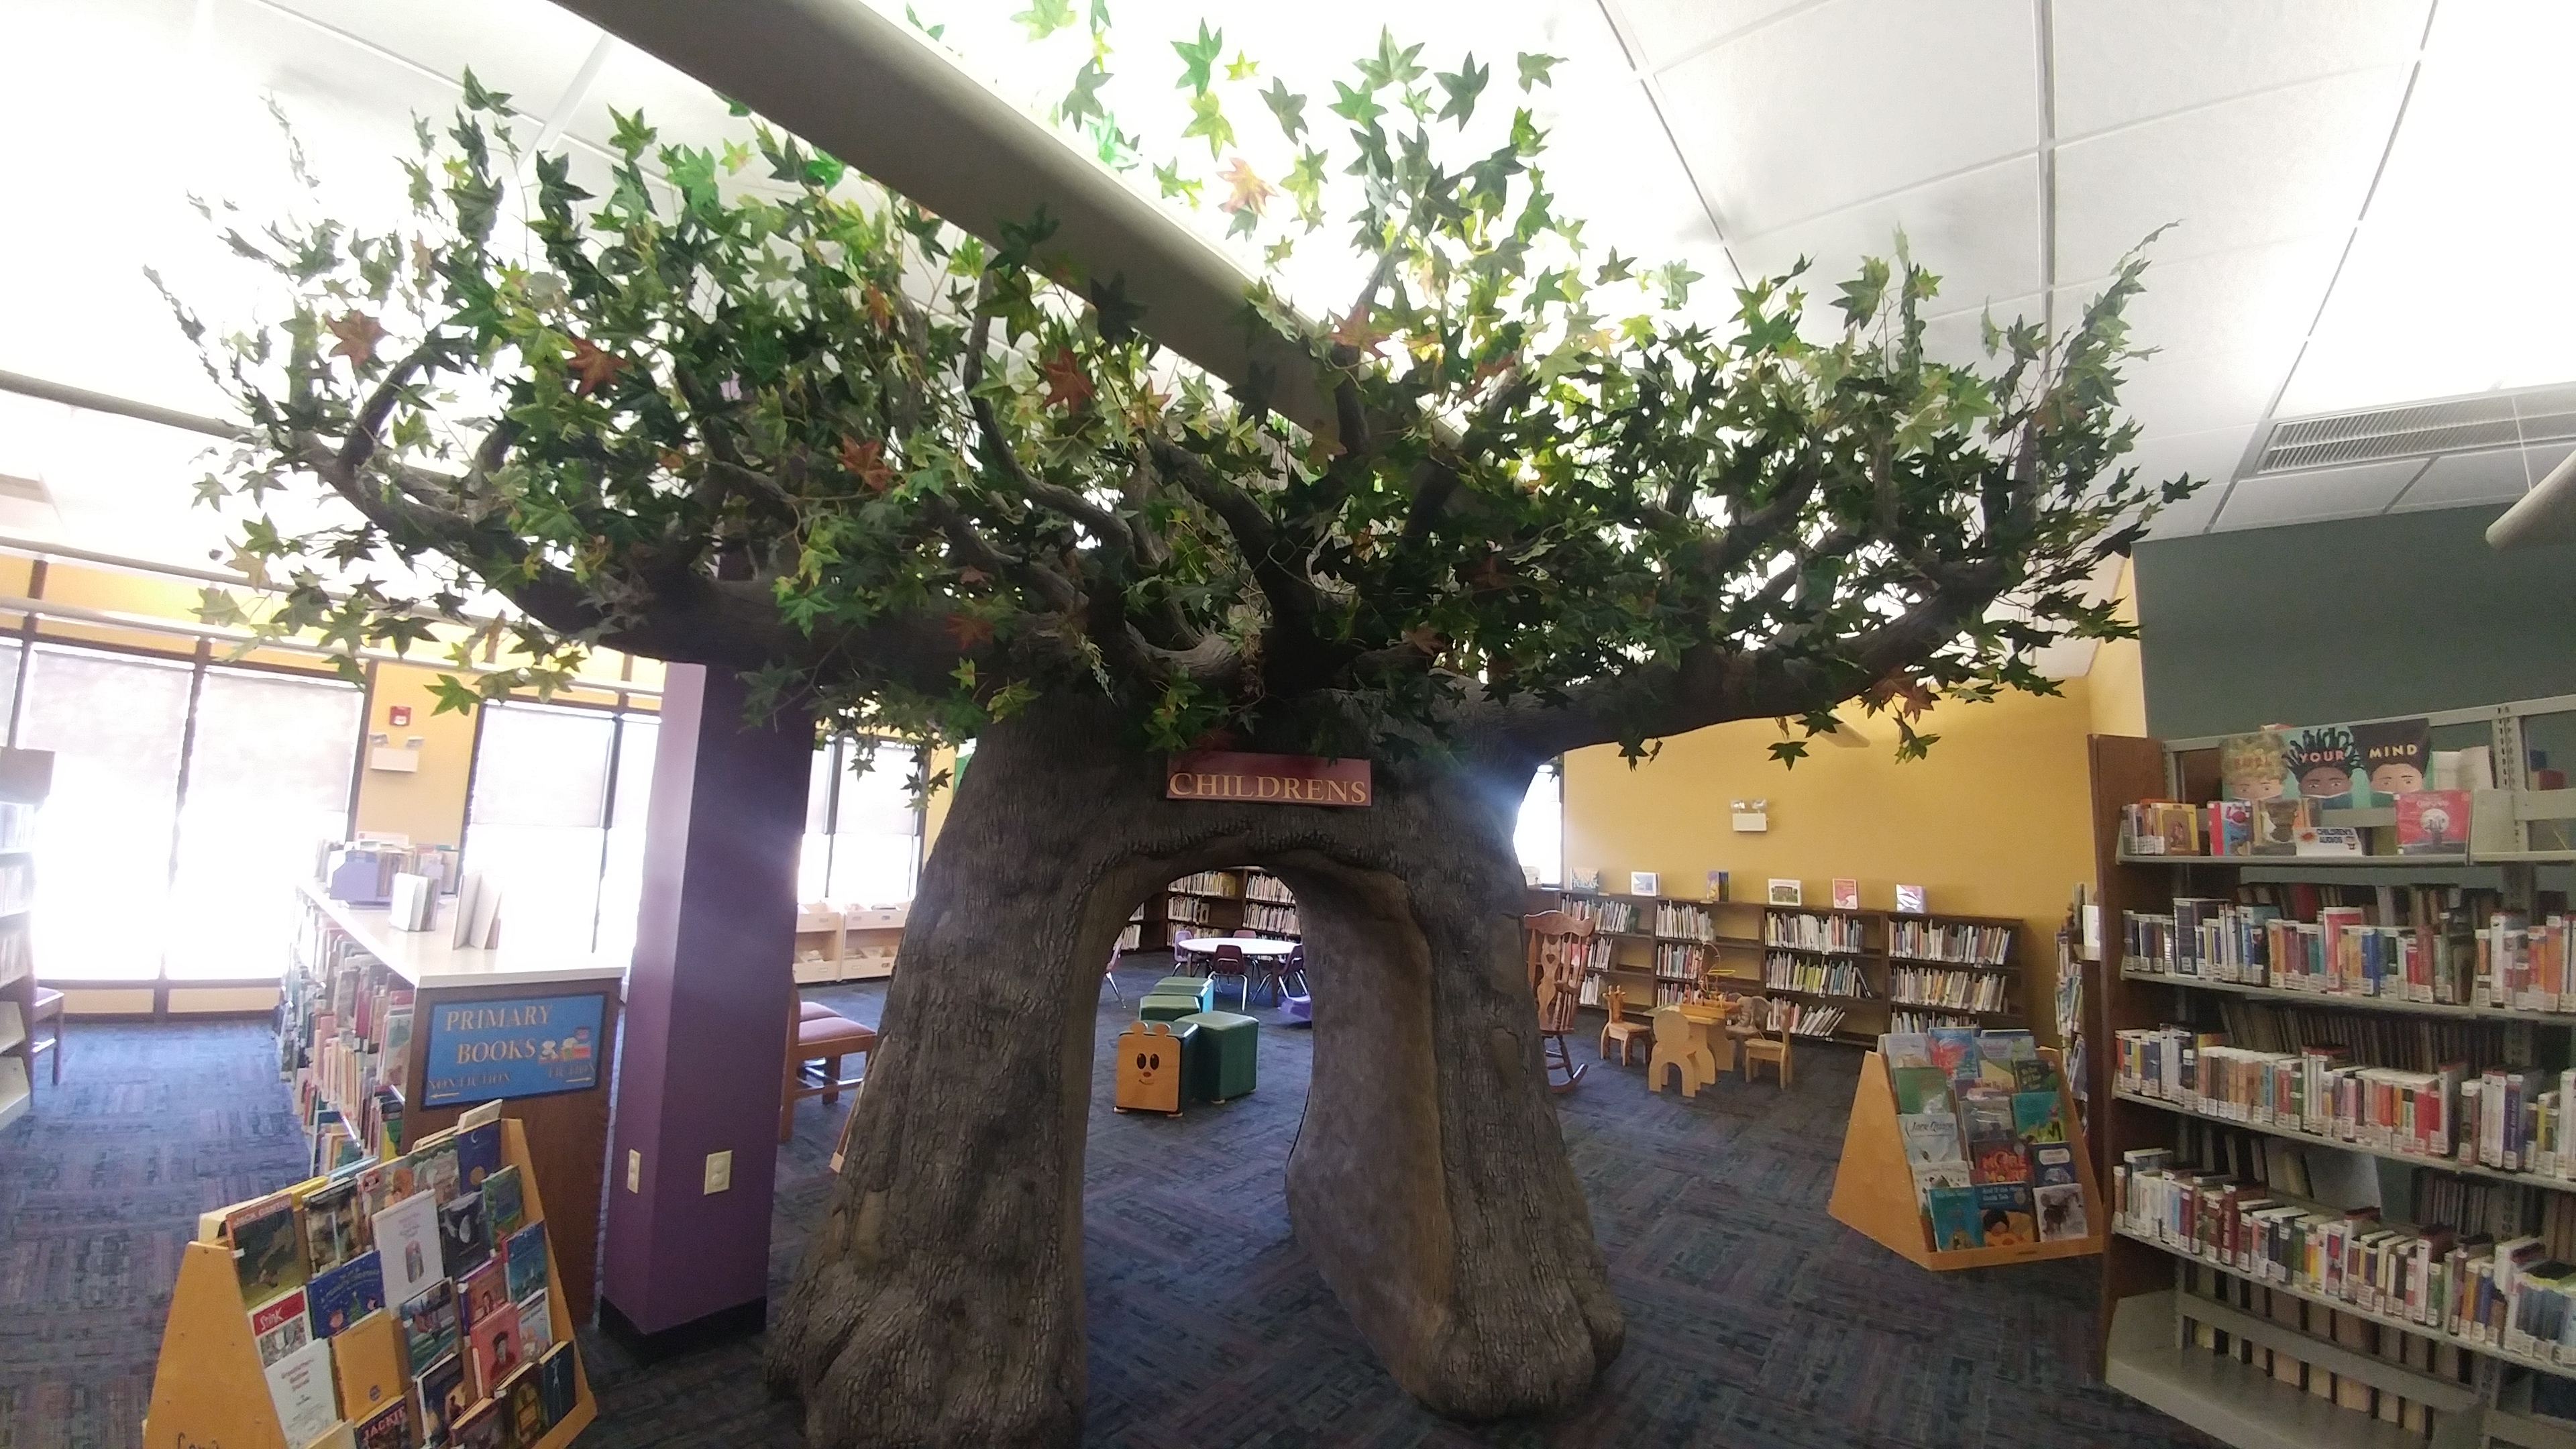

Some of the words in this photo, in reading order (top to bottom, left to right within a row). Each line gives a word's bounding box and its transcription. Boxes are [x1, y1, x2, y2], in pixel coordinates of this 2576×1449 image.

[2300, 750, 2346, 763] YOUR
[2369, 744, 2418, 759] MIND
[1169, 772, 1366, 804] CHILDRENS
[1573, 878, 1599, 889] TODAY
[445, 1005, 552, 1031] PRIMARY
[456, 1038, 536, 1064] BOOKS
